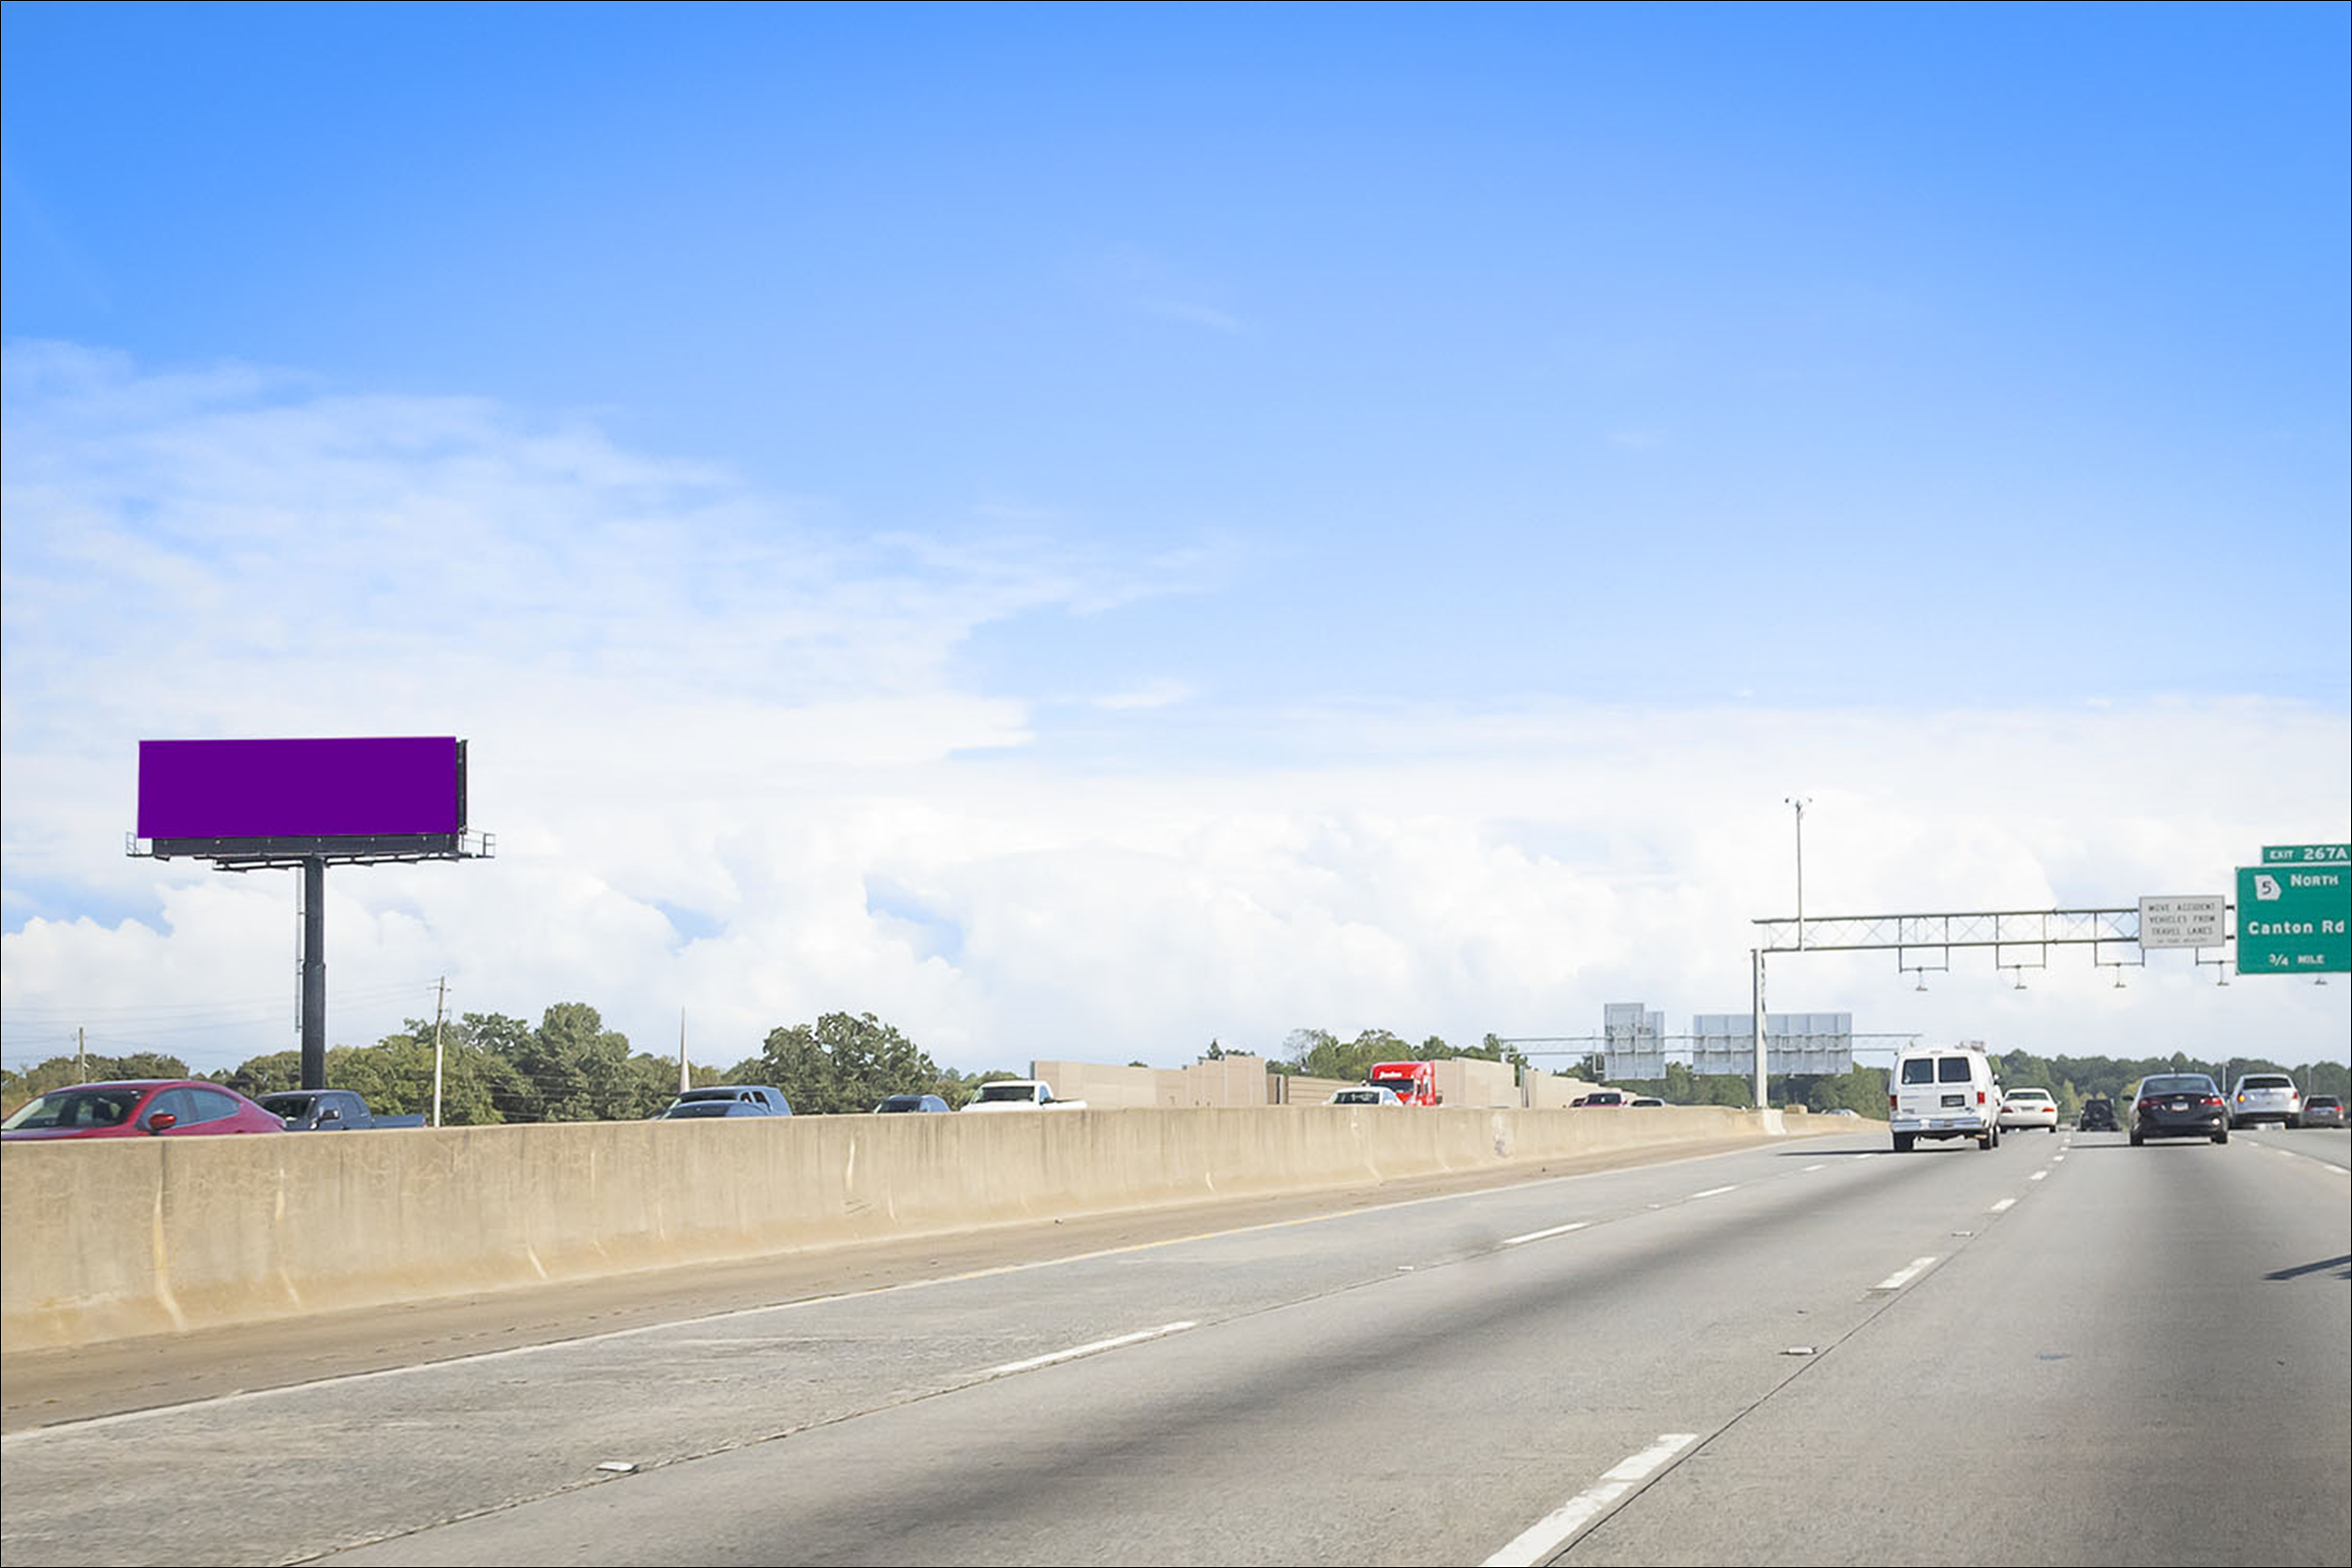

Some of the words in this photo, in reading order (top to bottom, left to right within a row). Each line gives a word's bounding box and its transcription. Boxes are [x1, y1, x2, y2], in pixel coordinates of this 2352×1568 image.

[2270, 850, 2294, 859] EXIT
[2303, 847, 2348, 860] 267A
[2262, 881, 2272, 896] 5
[2177, 903, 2215, 911] ACCIDENT
[2193, 914, 2216, 923] FROM
[2248, 921, 2314, 935] Canton
[2322, 920, 2345, 934] Rd
[2297, 955, 2325, 964] MILE
